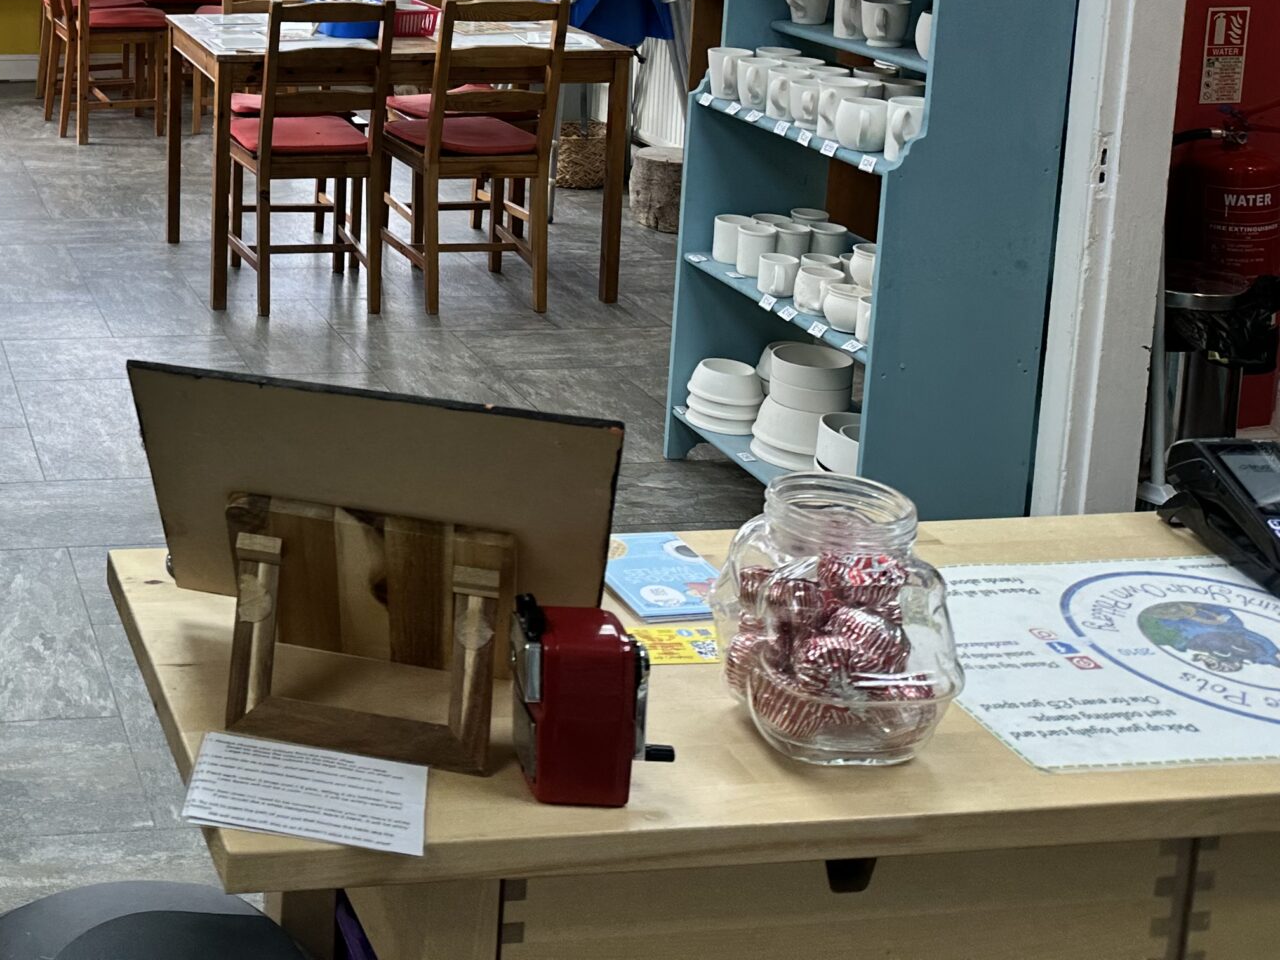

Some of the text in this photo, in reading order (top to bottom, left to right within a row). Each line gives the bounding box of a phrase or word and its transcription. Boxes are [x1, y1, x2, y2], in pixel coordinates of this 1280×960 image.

[1212, 48, 1239, 56] WATER
[1224, 193, 1272, 207] WATER
[1179, 672, 1252, 708] Pots
